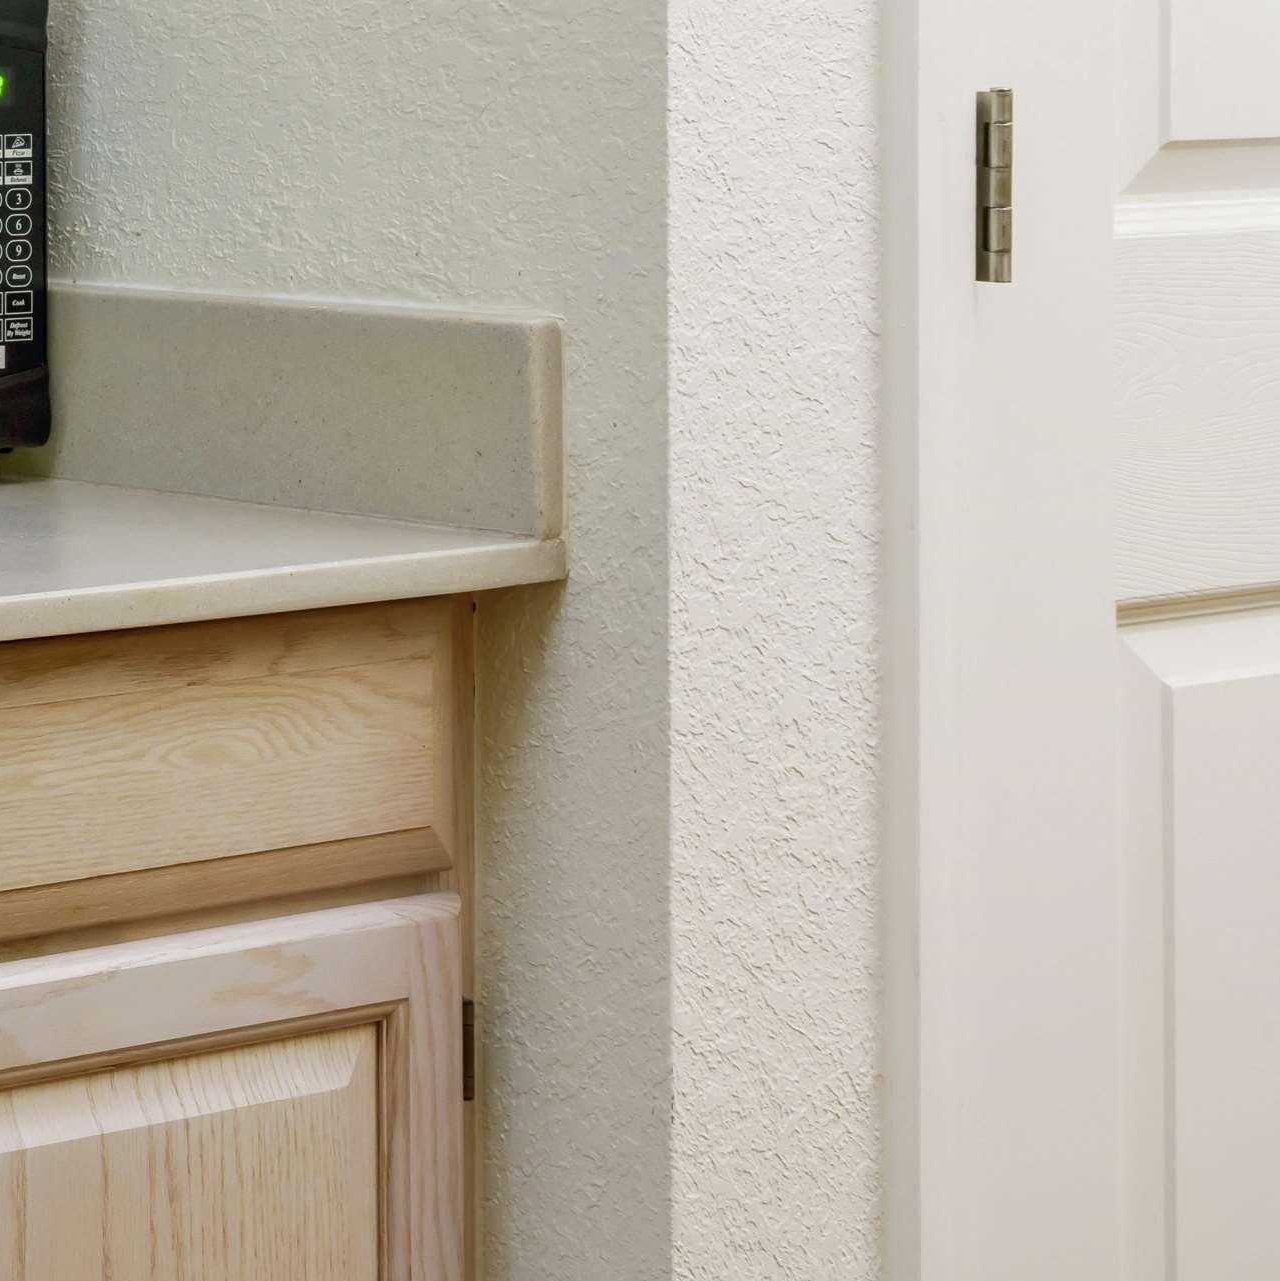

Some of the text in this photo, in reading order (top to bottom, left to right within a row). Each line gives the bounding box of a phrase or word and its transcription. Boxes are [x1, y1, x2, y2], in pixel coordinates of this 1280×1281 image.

[16, 193, 22, 205] 3
[15, 218, 22, 231] 6
[15, 244, 22, 257] 9
